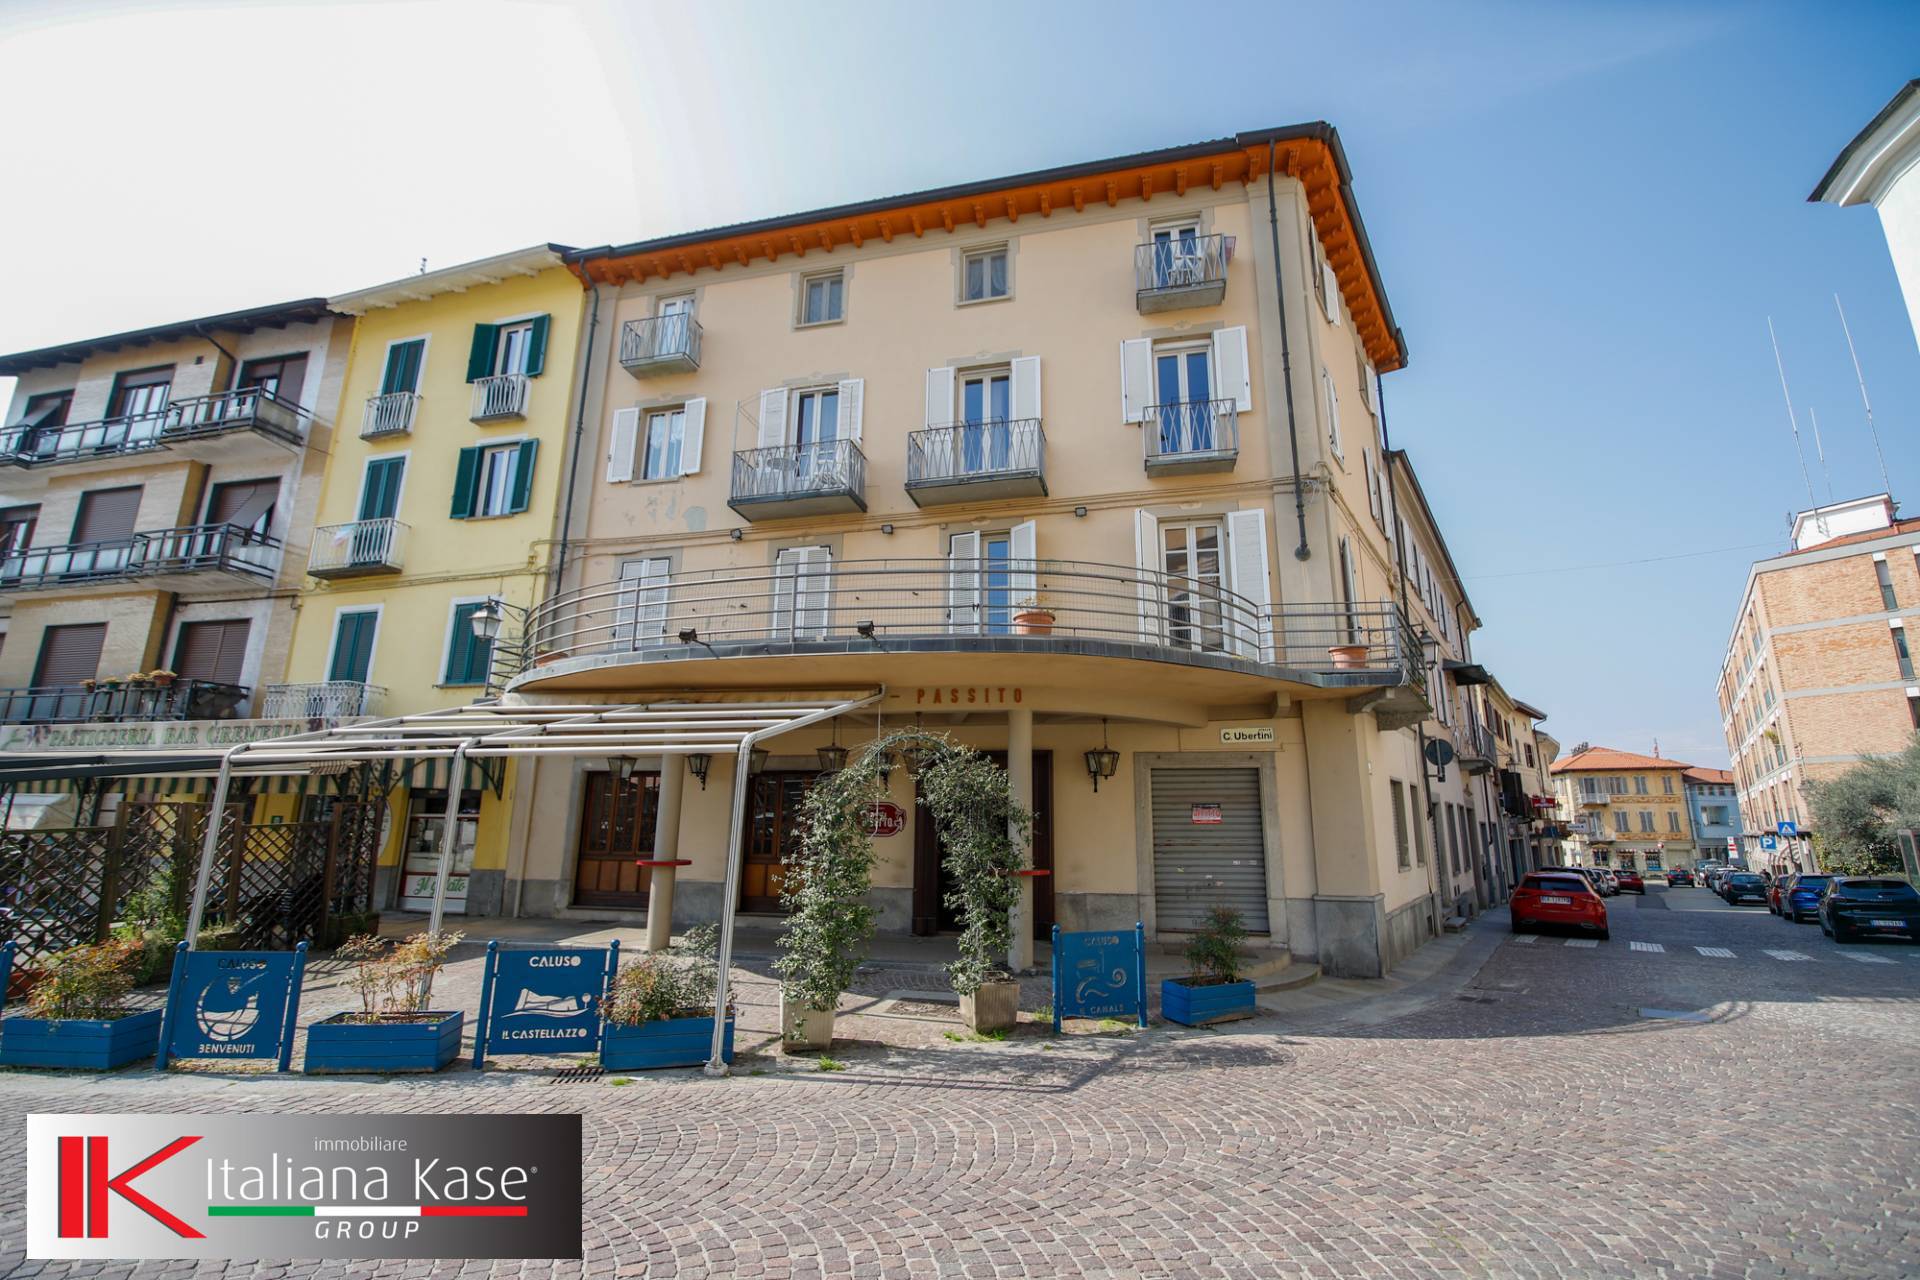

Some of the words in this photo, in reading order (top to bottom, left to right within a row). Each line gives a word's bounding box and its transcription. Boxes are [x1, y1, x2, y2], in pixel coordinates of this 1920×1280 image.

[916, 687, 1022, 704] PASSITO
[49, 726, 156, 746] PASTICCERIA
[164, 726, 199, 745] BAR
[205, 722, 301, 745] CREMERIA
[1233, 731, 1273, 741] Ubertini
[529, 955, 581, 967] CALUSO
[502, 1030, 510, 1039] IL
[511, 1028, 587, 1039] CASTELLAZZO
[198, 1043, 255, 1054] BENVENUTI
